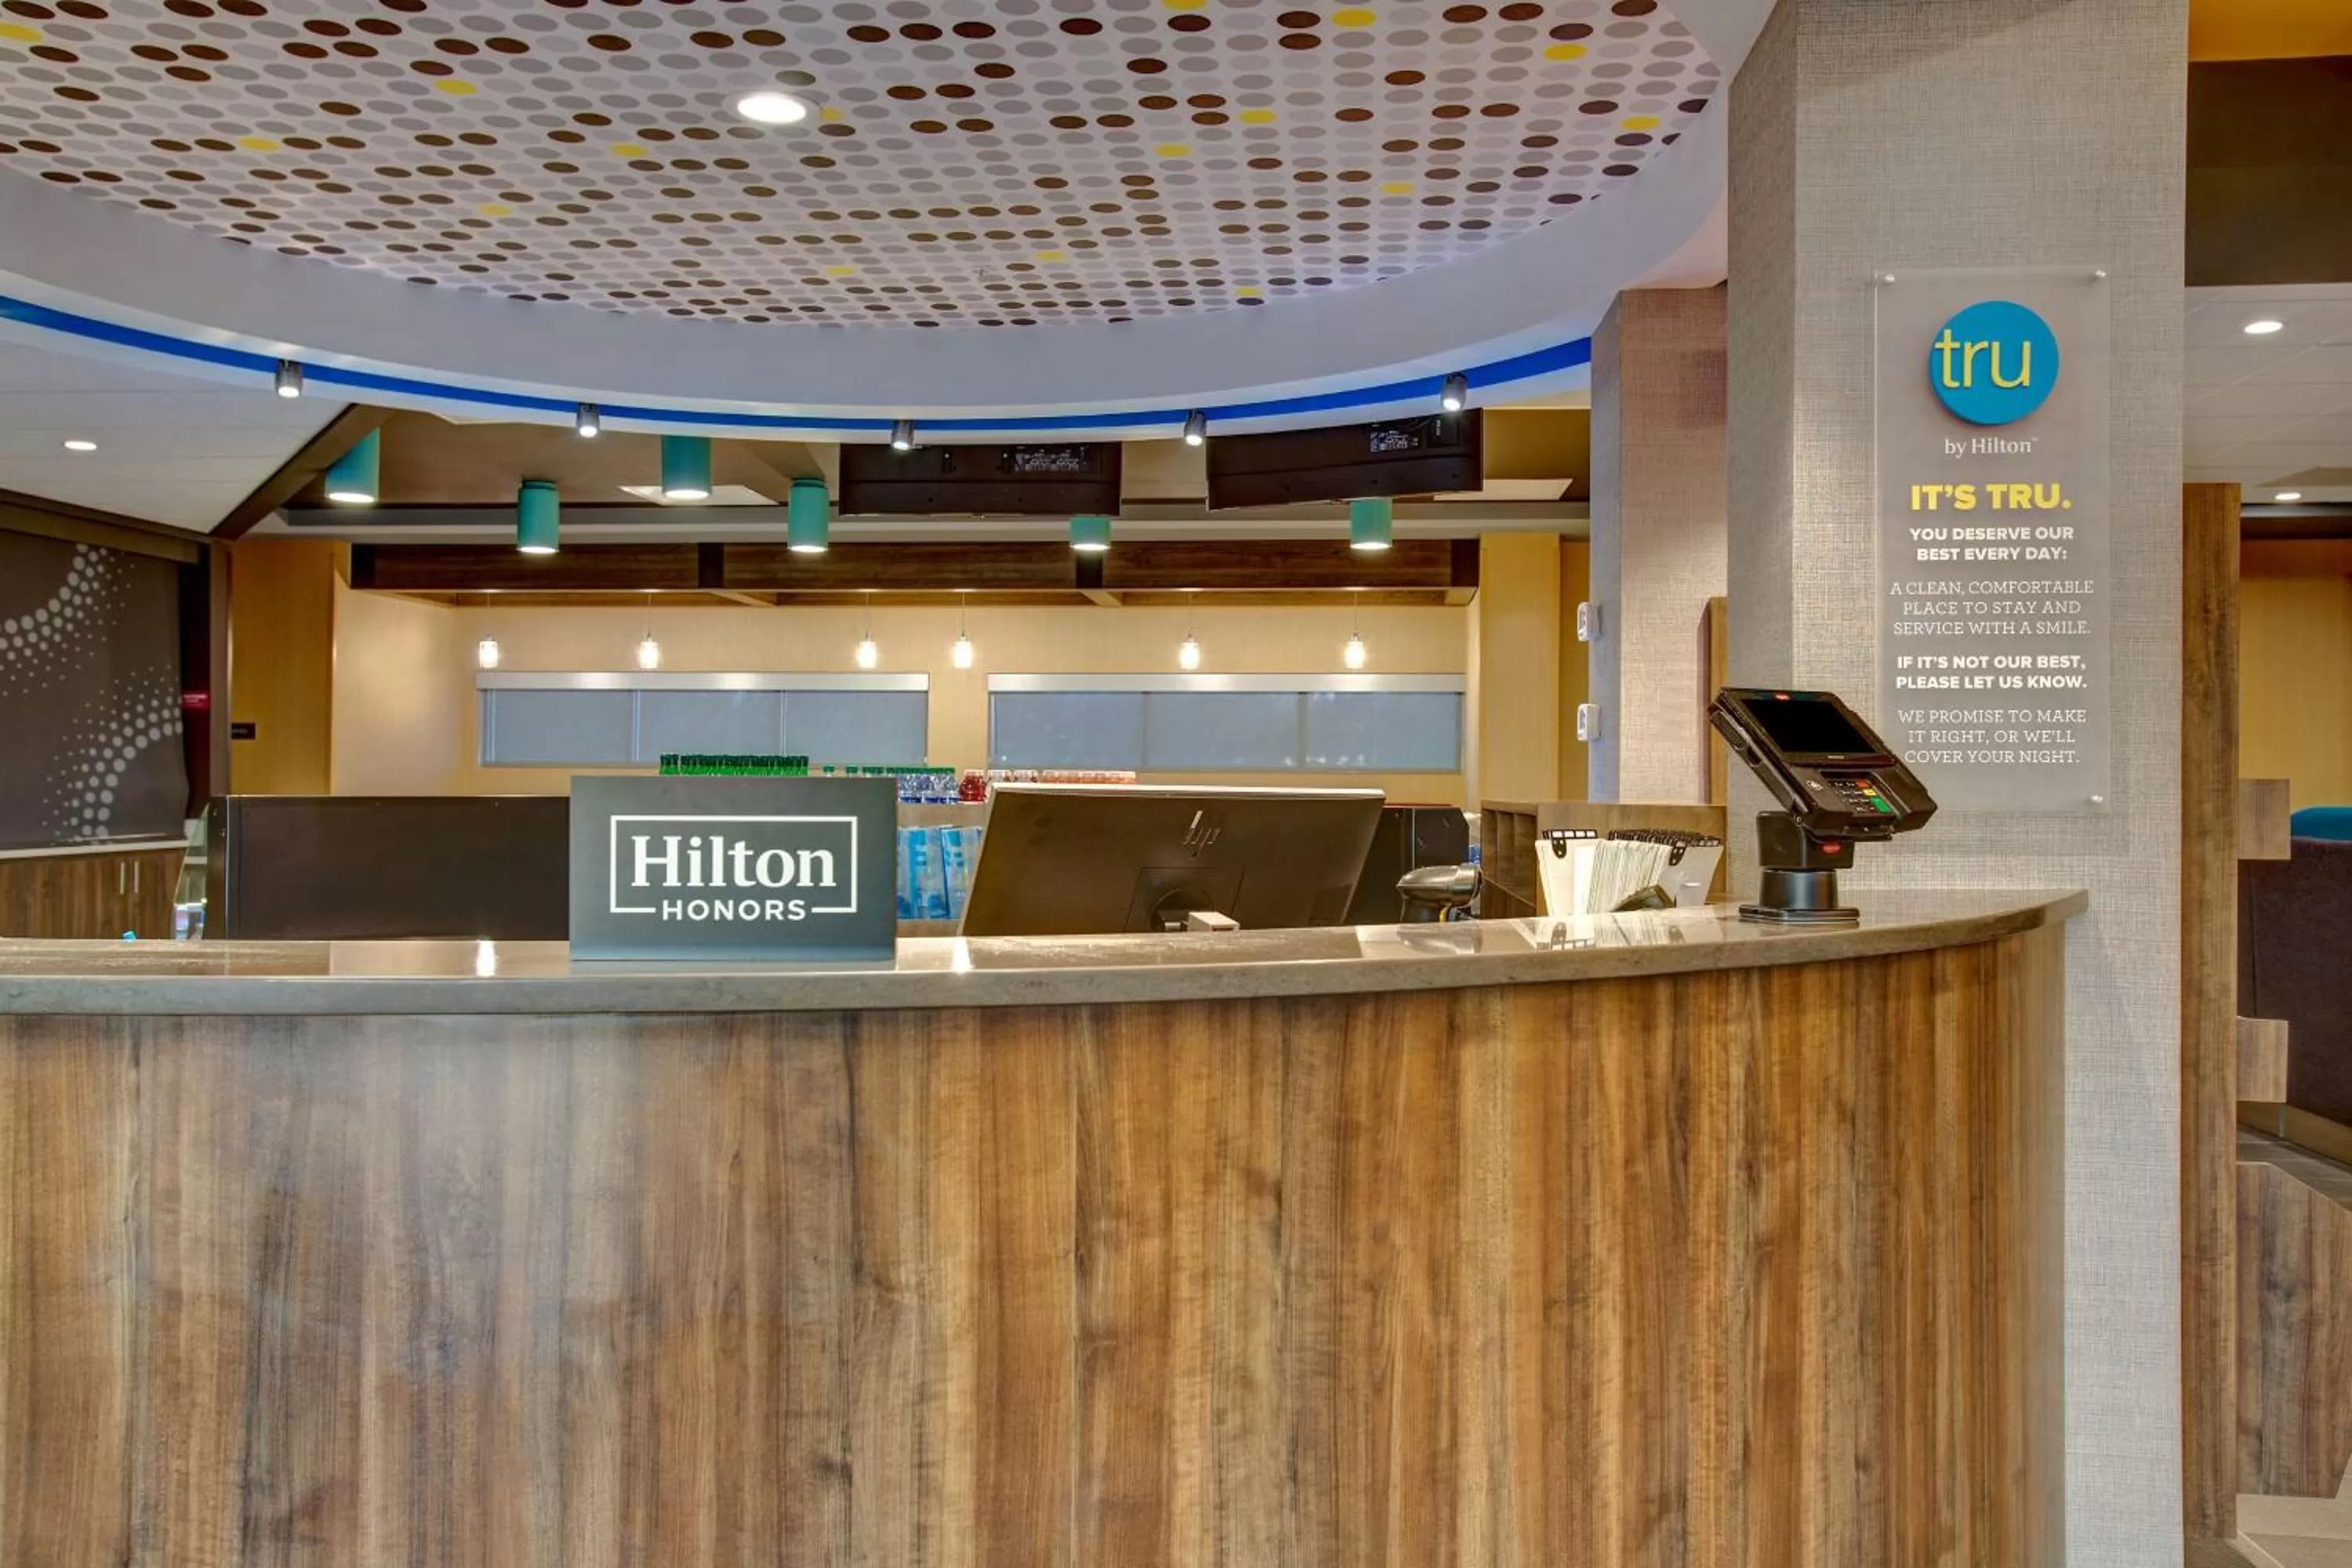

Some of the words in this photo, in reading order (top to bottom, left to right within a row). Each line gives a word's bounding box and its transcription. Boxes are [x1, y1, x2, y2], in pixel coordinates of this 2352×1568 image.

[1934, 328, 2031, 388] tru
[1944, 438, 1967, 459] by
[1911, 484, 1976, 510] IT'S
[1986, 483, 2071, 510] TRU.
[1909, 528, 1948, 540] YOU
[1952, 527, 2031, 540] DESERVE
[2035, 526, 2074, 539] OUR
[1917, 548, 1960, 561] BEST
[1965, 547, 2020, 560] EVERY
[2025, 546, 2067, 560] DAY:
[1889, 583, 1902, 595] A
[1906, 581, 1965, 596] CLEAN,
[1969, 580, 2094, 594] COMFORTABLE
[1903, 601, 1958, 615] PLACE
[1962, 601, 1987, 614] TO
[1992, 601, 2037, 614] STAY
[2042, 600, 2081, 614] AND
[1893, 622, 1964, 634] SERVICE
[1968, 622, 2015, 634] WITH
[2020, 622, 2032, 633] A
[2036, 620, 2092, 633] SMILE.
[1897, 656, 1913, 669] IF
[1918, 656, 1948, 668] IT'S
[1953, 656, 1990, 668] NOT
[1994, 656, 2032, 668] OUR
[2037, 655, 2086, 670] BEST,
[1896, 676, 1960, 688] PLEASE
[1965, 676, 1994, 688] LET
[1999, 676, 2024, 688] US
[2027, 675, 2087, 688] KNOW.
[1898, 710, 1925, 723] WE
[1929, 710, 2004, 723] PROMISE
[2008, 710, 2033, 722] TO
[2037, 710, 2086, 722] MAKE
[1908, 730, 1926, 743] IT
[1930, 730, 1989, 745] RIGHT,
[1994, 730, 2019, 743] OR
[2024, 730, 2075, 742] WE'LL
[1904, 750, 1963, 764] COVER
[1967, 750, 2015, 764] YOUR
[2019, 750, 2081, 764] NIGHT.
[630, 836, 837, 887] Hilton
[662, 899, 806, 922] HONORS
